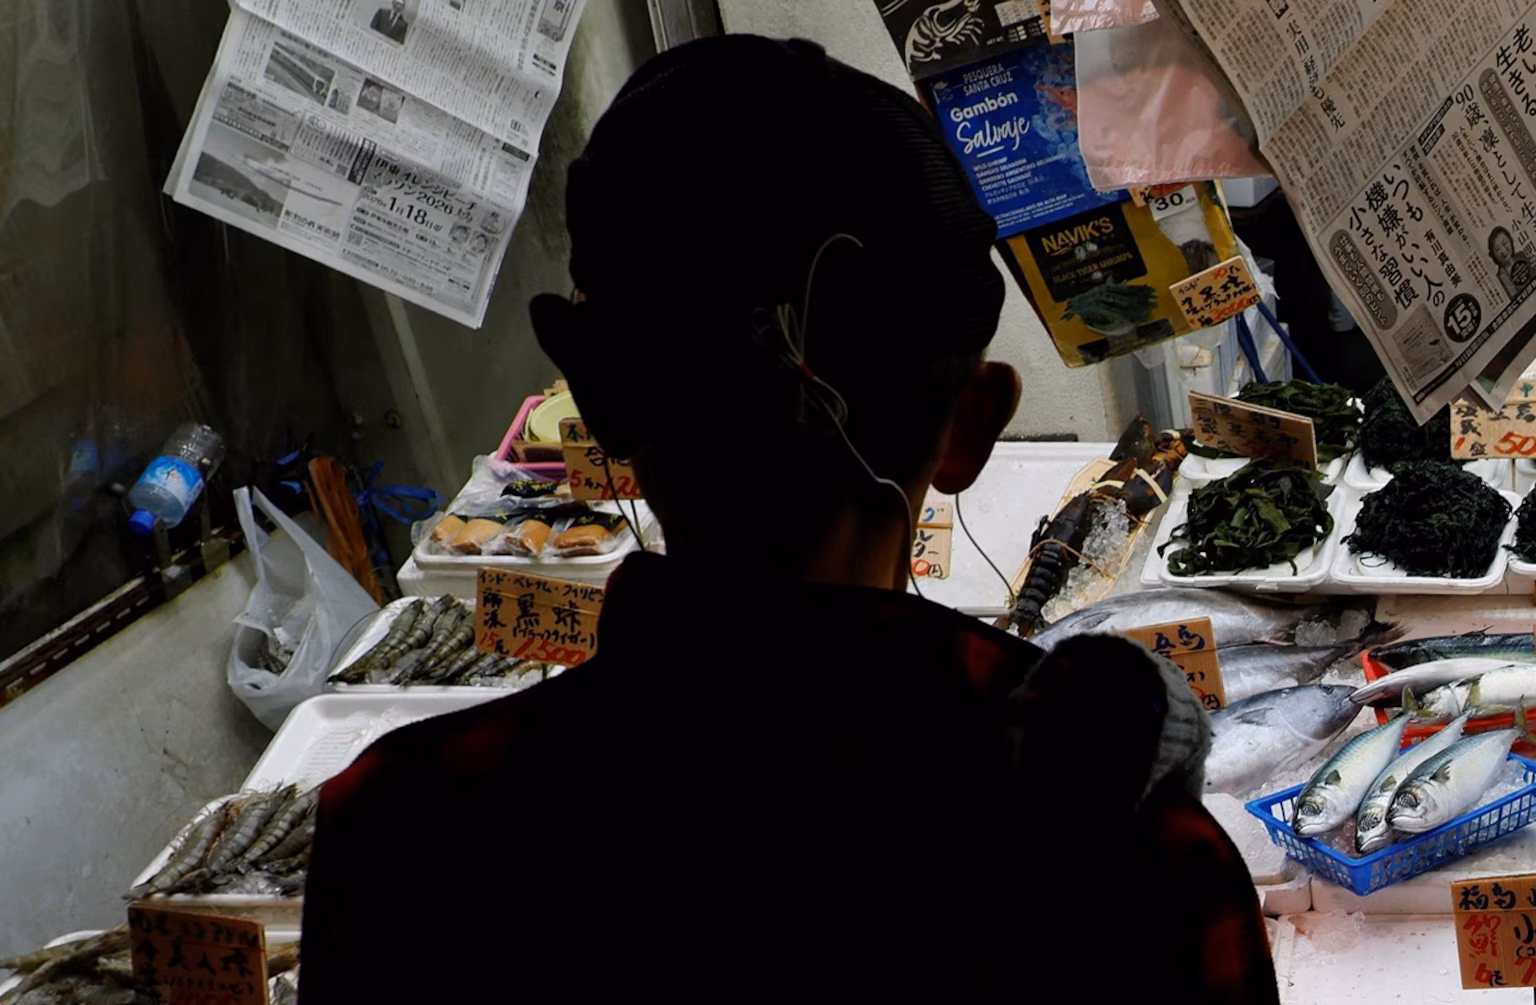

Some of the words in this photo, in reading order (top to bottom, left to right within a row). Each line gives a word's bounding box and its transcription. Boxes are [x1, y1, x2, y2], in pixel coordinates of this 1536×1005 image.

[963, 63, 1004, 84] PESQUERA
[963, 78, 989, 97] SANTA
[990, 71, 1013, 90] CRUZ
[950, 91, 1018, 123] Gambón
[956, 115, 1030, 155] Salvaje
[1156, 193, 1184, 212] 30
[1383, 164, 1423, 222] いつも
[1041, 216, 1114, 254] NAVIK'S
[1366, 181, 1445, 307] 機嫌がいい人の
[1350, 206, 1418, 310] 小さな習慣
[1459, 883, 1516, 910] 福島
